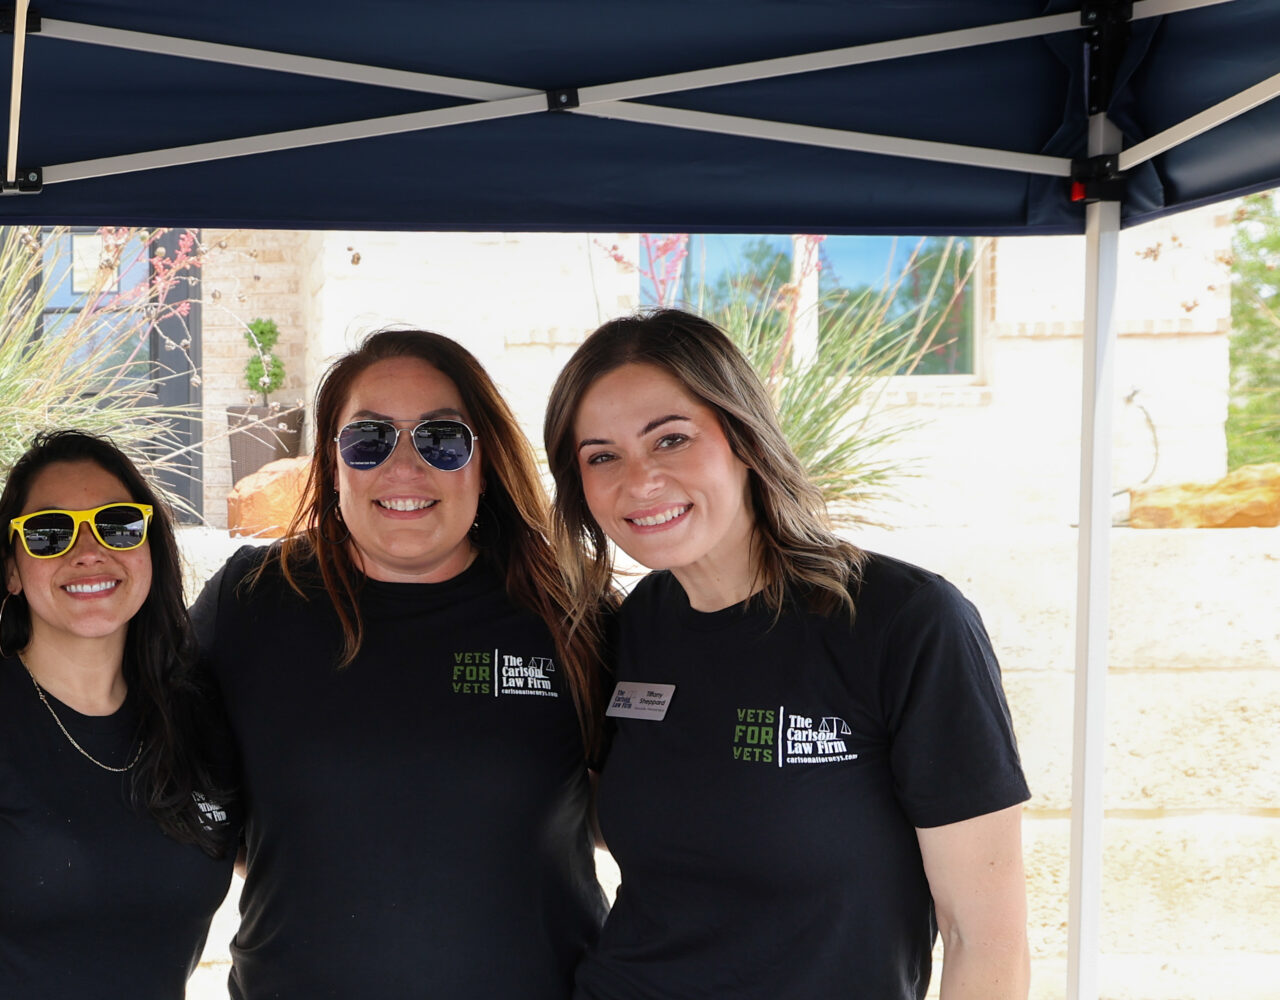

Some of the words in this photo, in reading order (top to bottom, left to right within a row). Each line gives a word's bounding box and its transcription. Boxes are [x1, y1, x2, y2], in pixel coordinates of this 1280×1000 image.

[454, 652, 491, 664] VETS
[502, 655, 523, 667] The
[452, 665, 491, 681] FOR
[501, 666, 541, 678] Carlson
[451, 681, 491, 694] VETS
[501, 676, 525, 688] Law
[527, 677, 551, 690] Firm
[736, 708, 776, 724] VETS
[788, 714, 813, 729] The
[733, 725, 774, 745] FOR
[786, 728, 837, 742] Carlson
[732, 746, 773, 763] VETS
[786, 740, 813, 755] Law
[816, 740, 848, 755] Firm
[786, 753, 858, 764] carlsonattorneys.com
